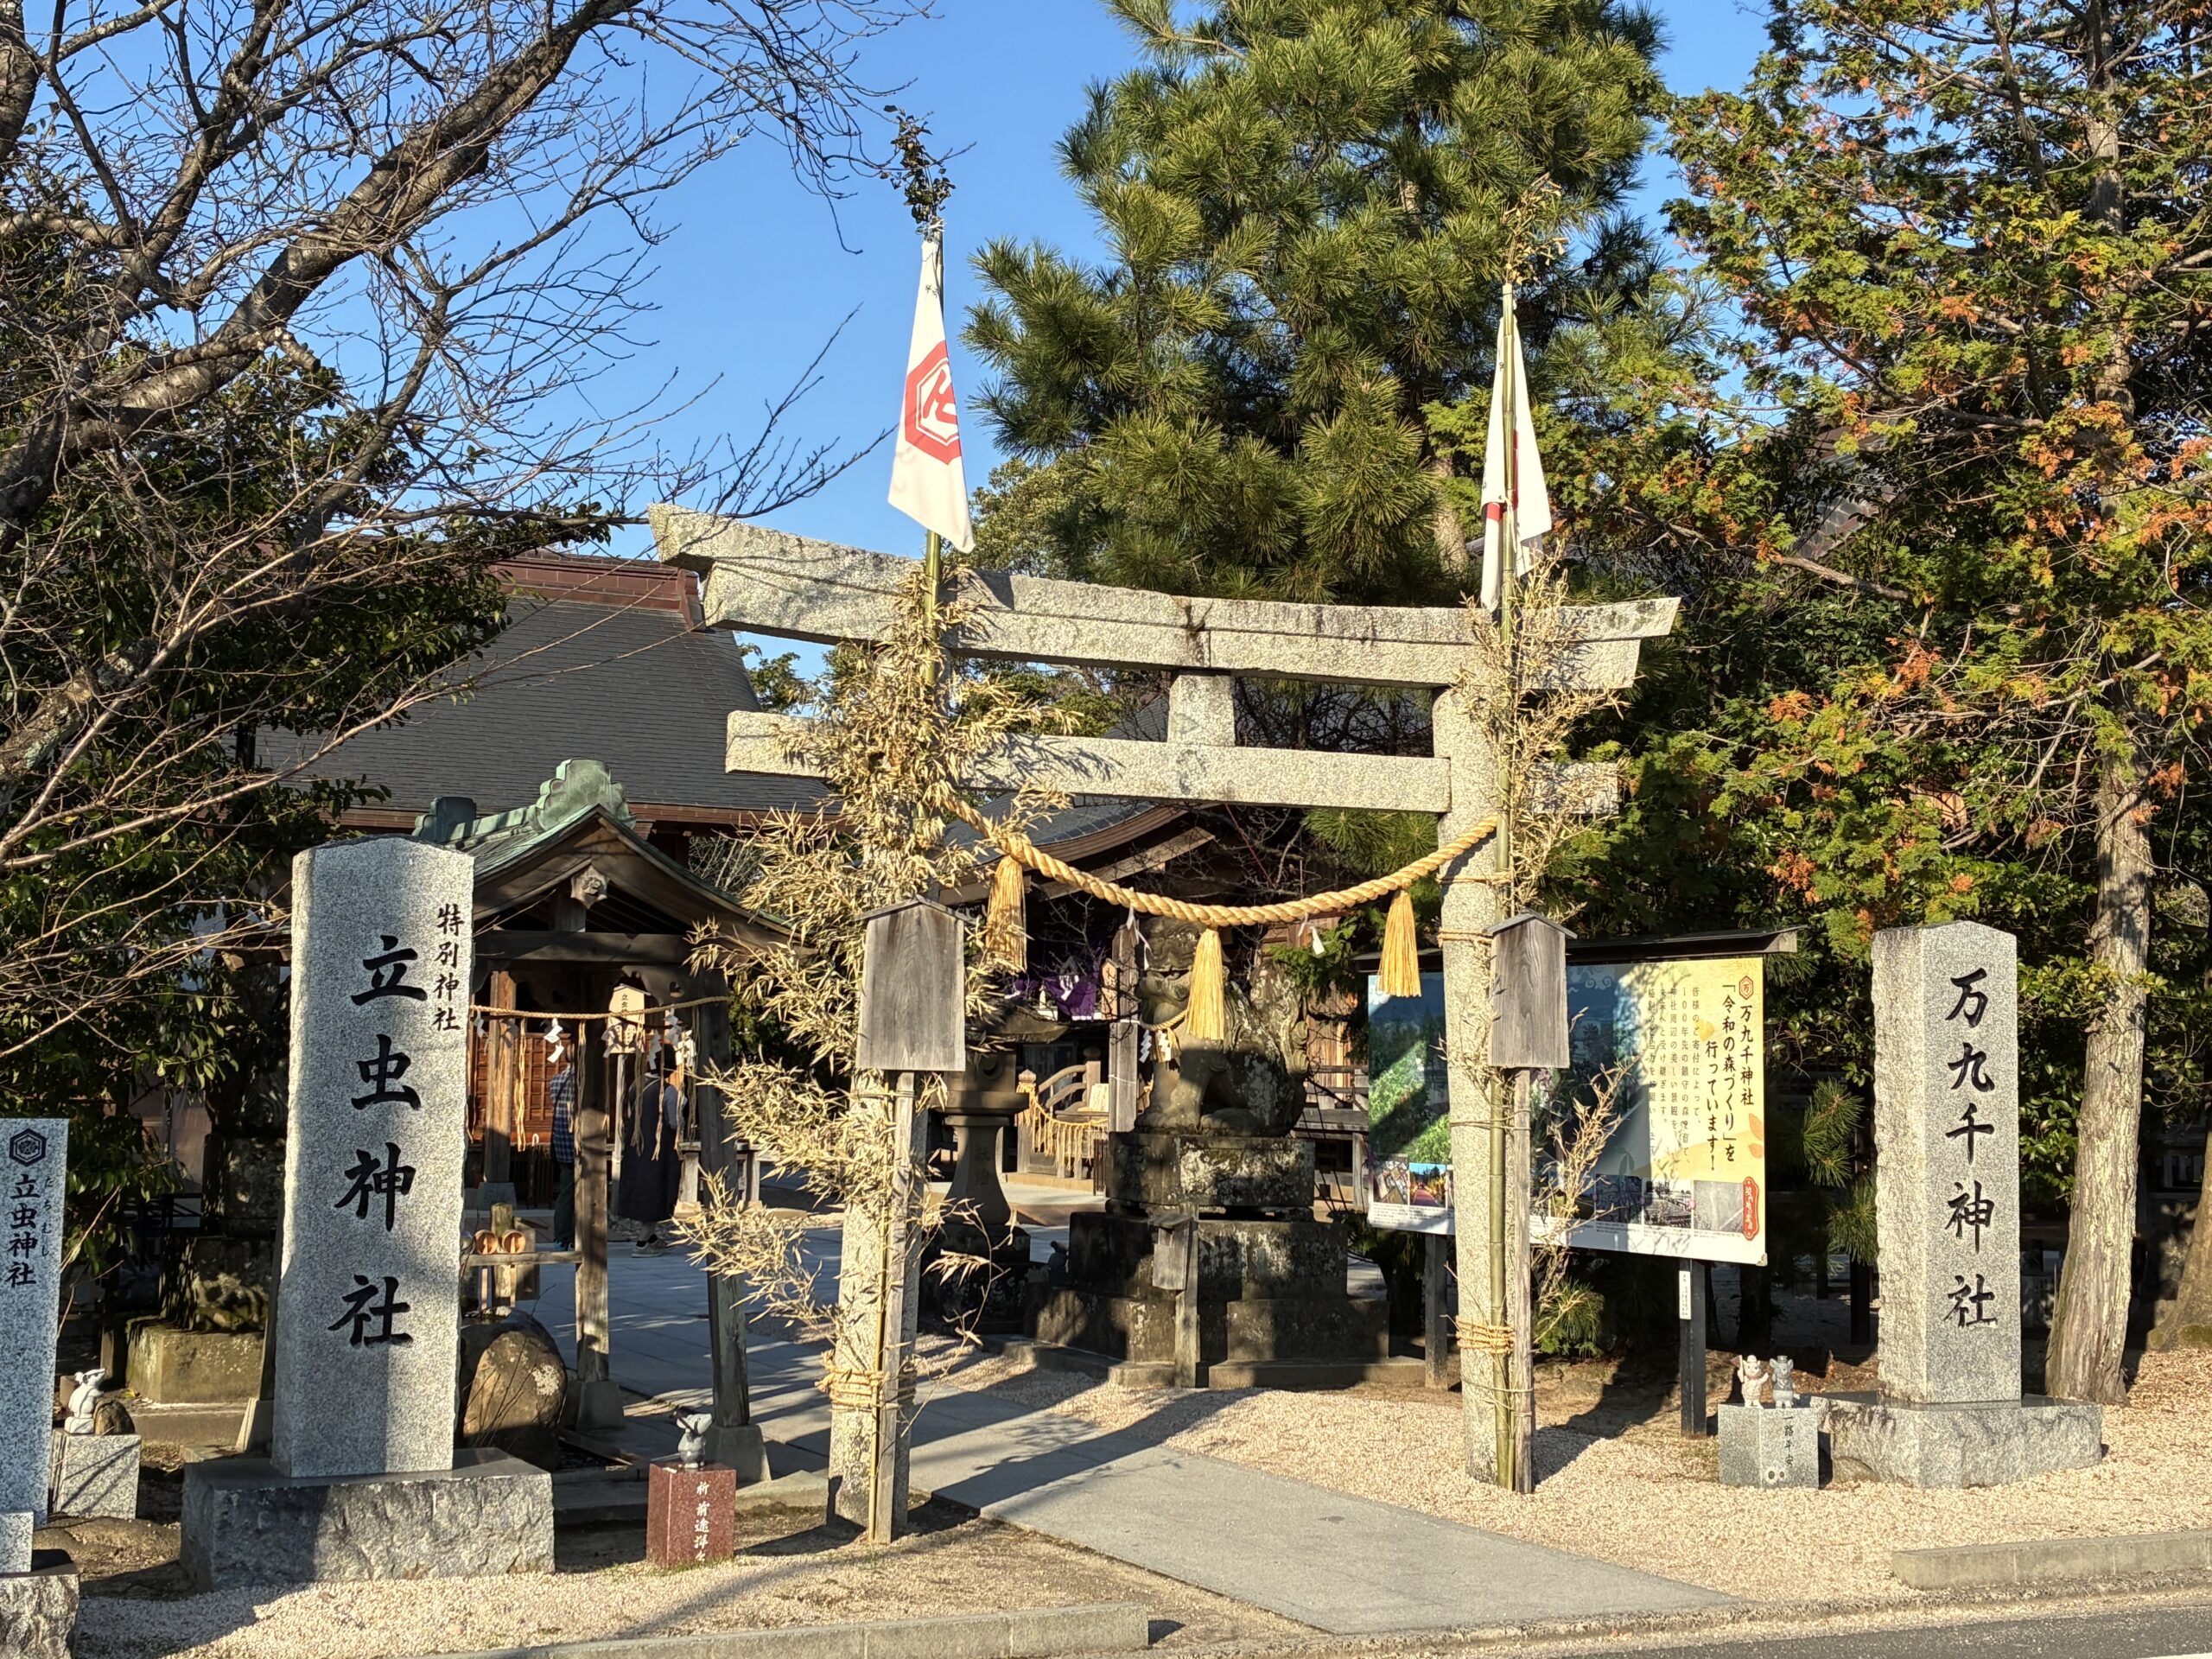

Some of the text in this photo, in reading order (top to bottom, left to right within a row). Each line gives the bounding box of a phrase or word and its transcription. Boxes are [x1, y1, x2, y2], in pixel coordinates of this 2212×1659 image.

[431, 904, 465, 1033] 特別神社
[1721, 983, 1737, 1162] 「令和の森づくり」を
[1739, 1004, 1755, 1106] 万九千神社
[327, 935, 427, 1348] 立虫神社
[1945, 967, 1998, 1330] 万九千神社
[4, 1173, 41, 1288] 立虫神社
[41, 1176, 54, 1256] たちむし
[1783, 1415, 1795, 1469] 一路平安
